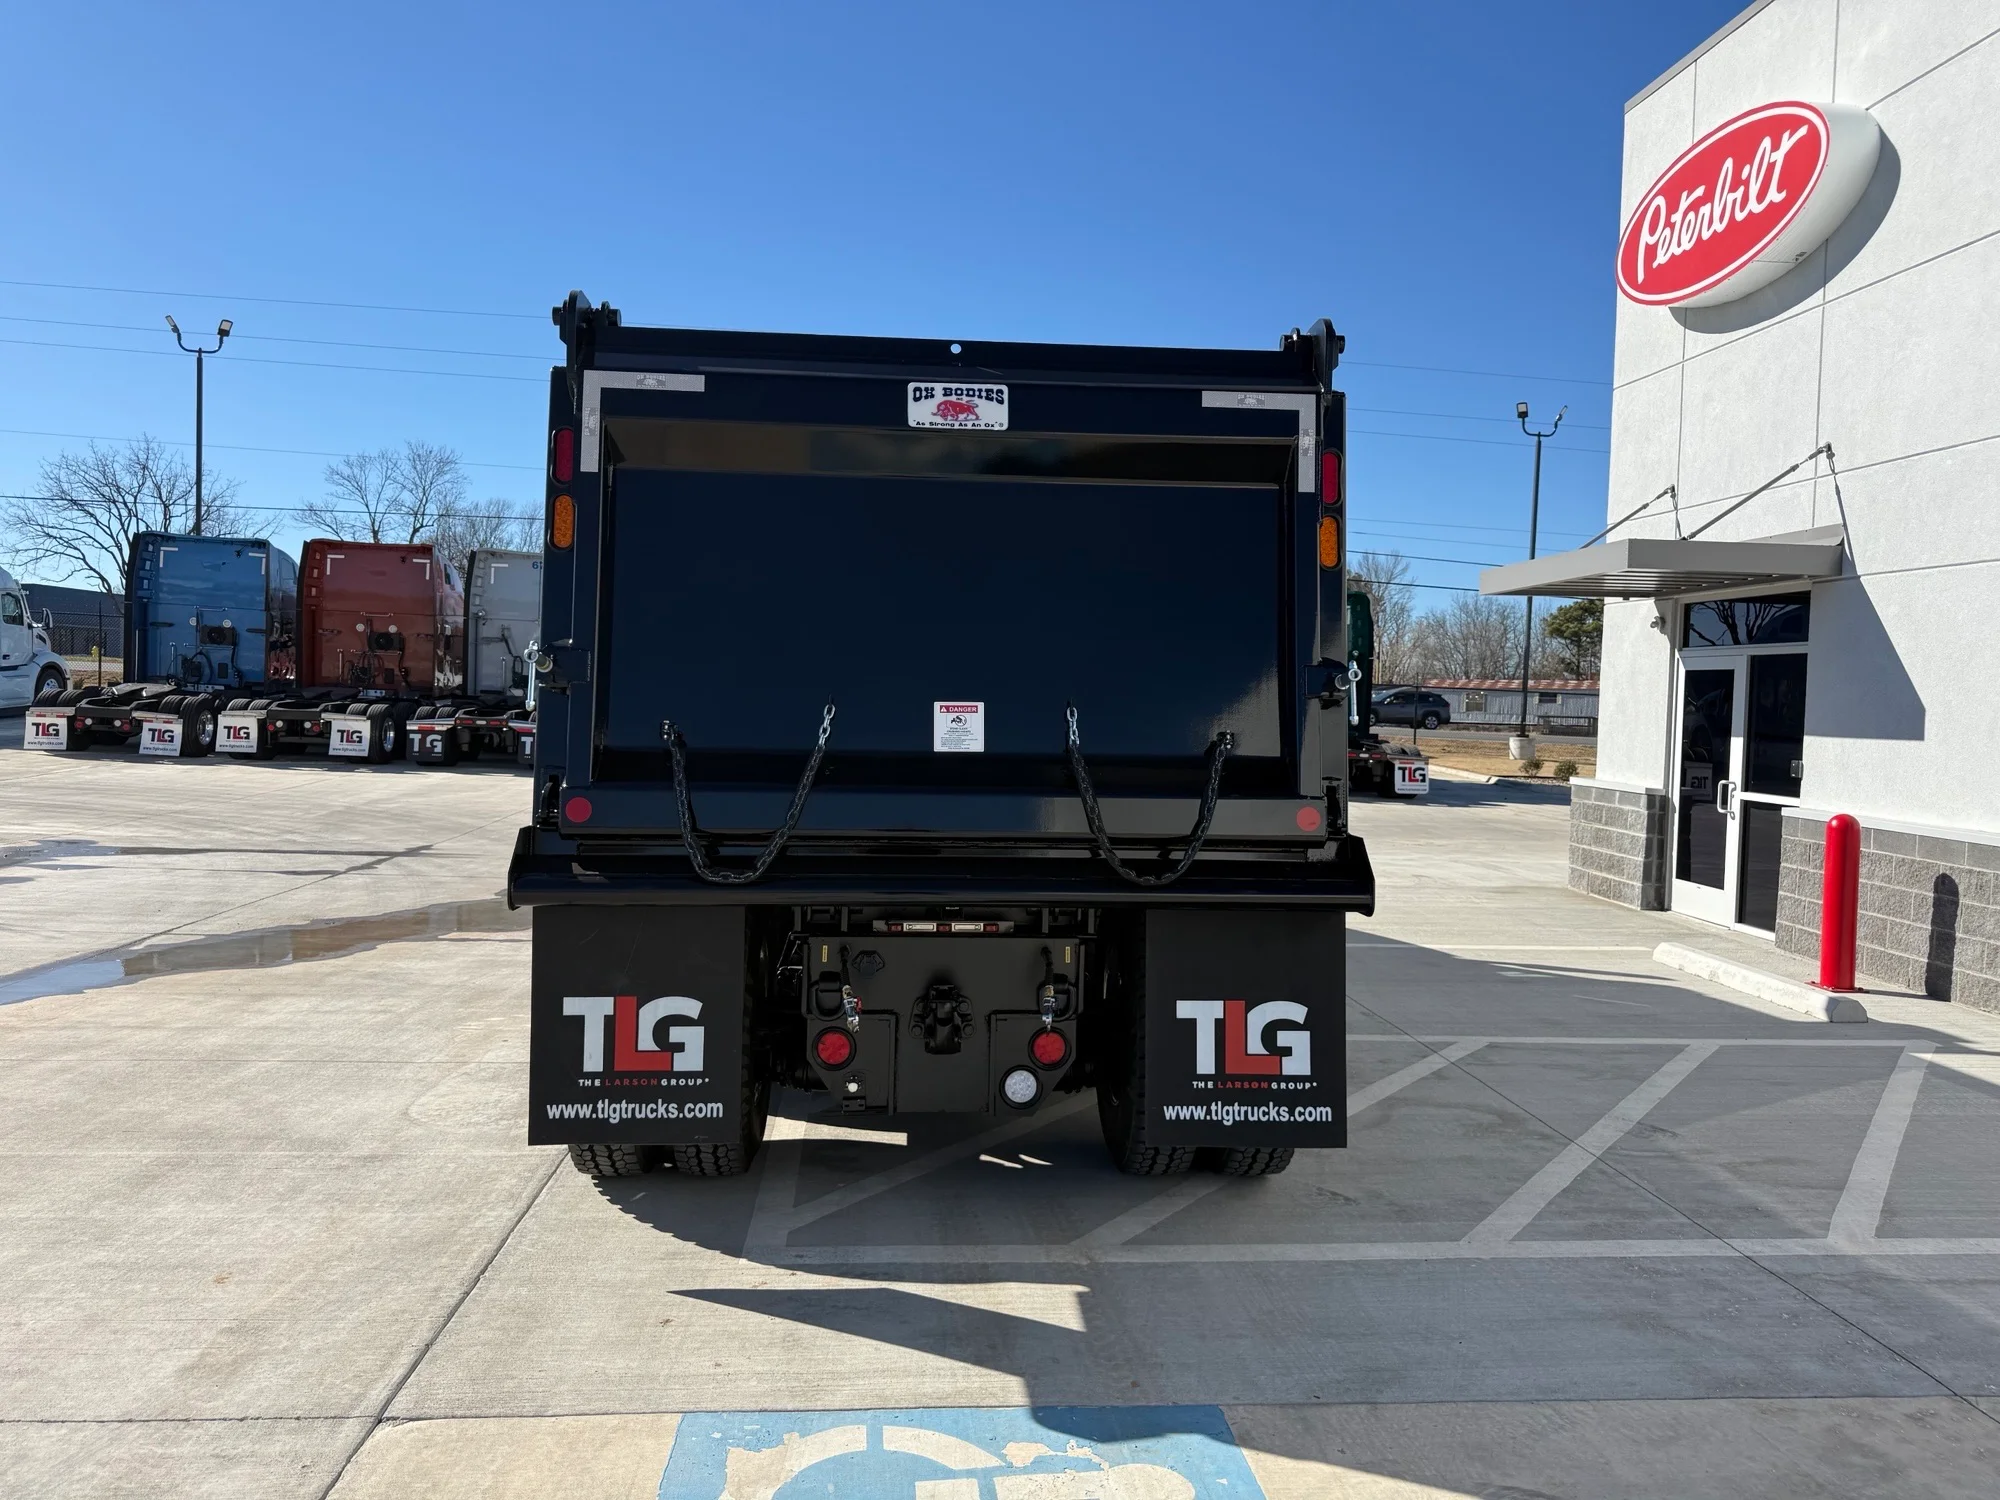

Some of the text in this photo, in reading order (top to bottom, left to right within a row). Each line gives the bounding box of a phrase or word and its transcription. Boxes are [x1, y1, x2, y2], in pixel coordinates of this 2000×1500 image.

[1637, 124, 1809, 285] Peterbilt
[912, 386, 1005, 405] OX BODIES
[31, 722, 60, 737] TLG
[148, 728, 175, 743] TLG
[223, 725, 251, 740] TLG
[337, 729, 363, 744] TLG
[1397, 766, 1427, 783] TLG
[562, 996, 705, 1073] TLG
[1176, 1000, 1311, 1076] TLG
[578, 1079, 601, 1087] THE
[605, 1078, 658, 1086] LARSON
[1192, 1081, 1214, 1089] THE
[1218, 1081, 1268, 1089] LARSON
[547, 1099, 724, 1124] www.tlgtrucks.com
[1163, 1101, 1332, 1126] www.tlgtrucks.com
